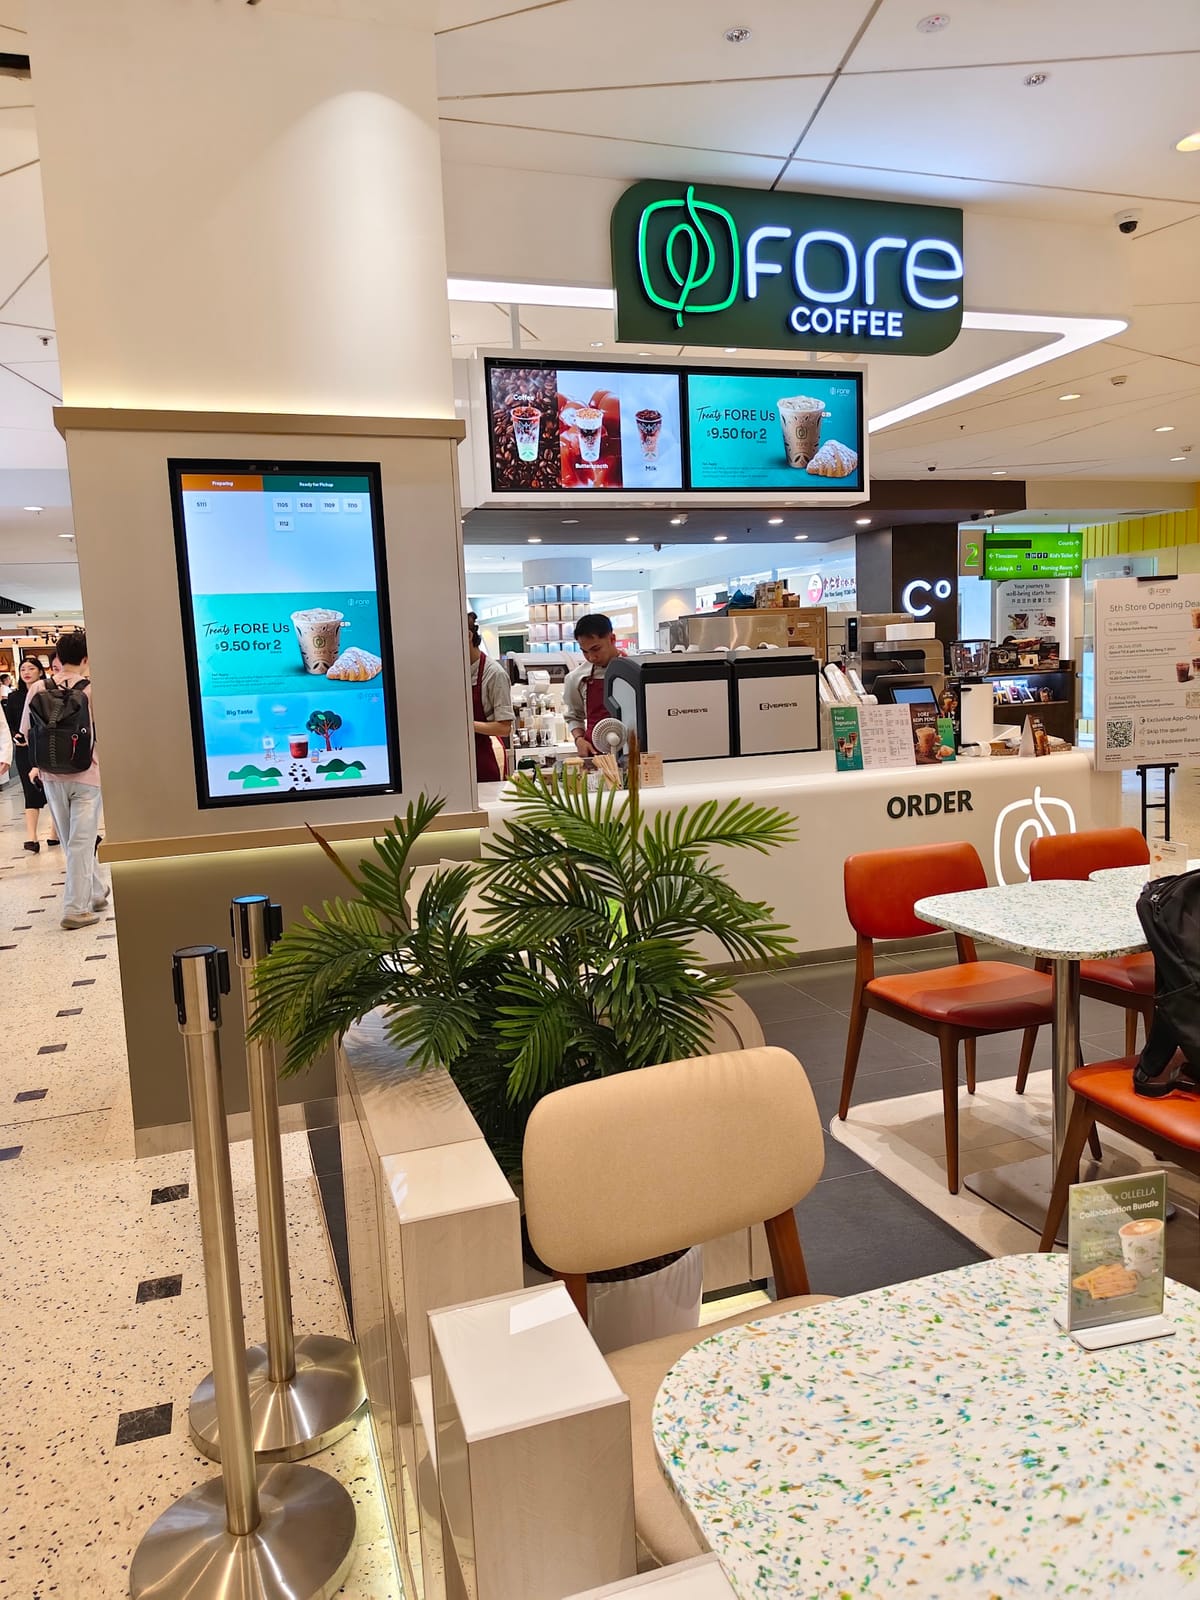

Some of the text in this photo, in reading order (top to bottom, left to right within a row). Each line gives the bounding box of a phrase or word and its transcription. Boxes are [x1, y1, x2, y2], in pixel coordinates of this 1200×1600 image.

[790, 306, 904, 338] COFFEE
[513, 393, 535, 401] Coffee
[696, 406, 775, 422] Treats FORE Us
[741, 427, 758, 440] for
[759, 428, 767, 439] 2
[964, 542, 980, 567] 2
[1110, 604, 1124, 612] 5th
[1125, 603, 1147, 612] Store
[1148, 601, 1184, 611] Opening
[202, 621, 290, 638] Treats FORE Us
[253, 639, 272, 651] for
[273, 639, 282, 650] 2
[886, 789, 974, 819] ORDER
[1120, 1186, 1156, 1200] OLLELLA
[1079, 1200, 1160, 1220] Collaboration Bundle
